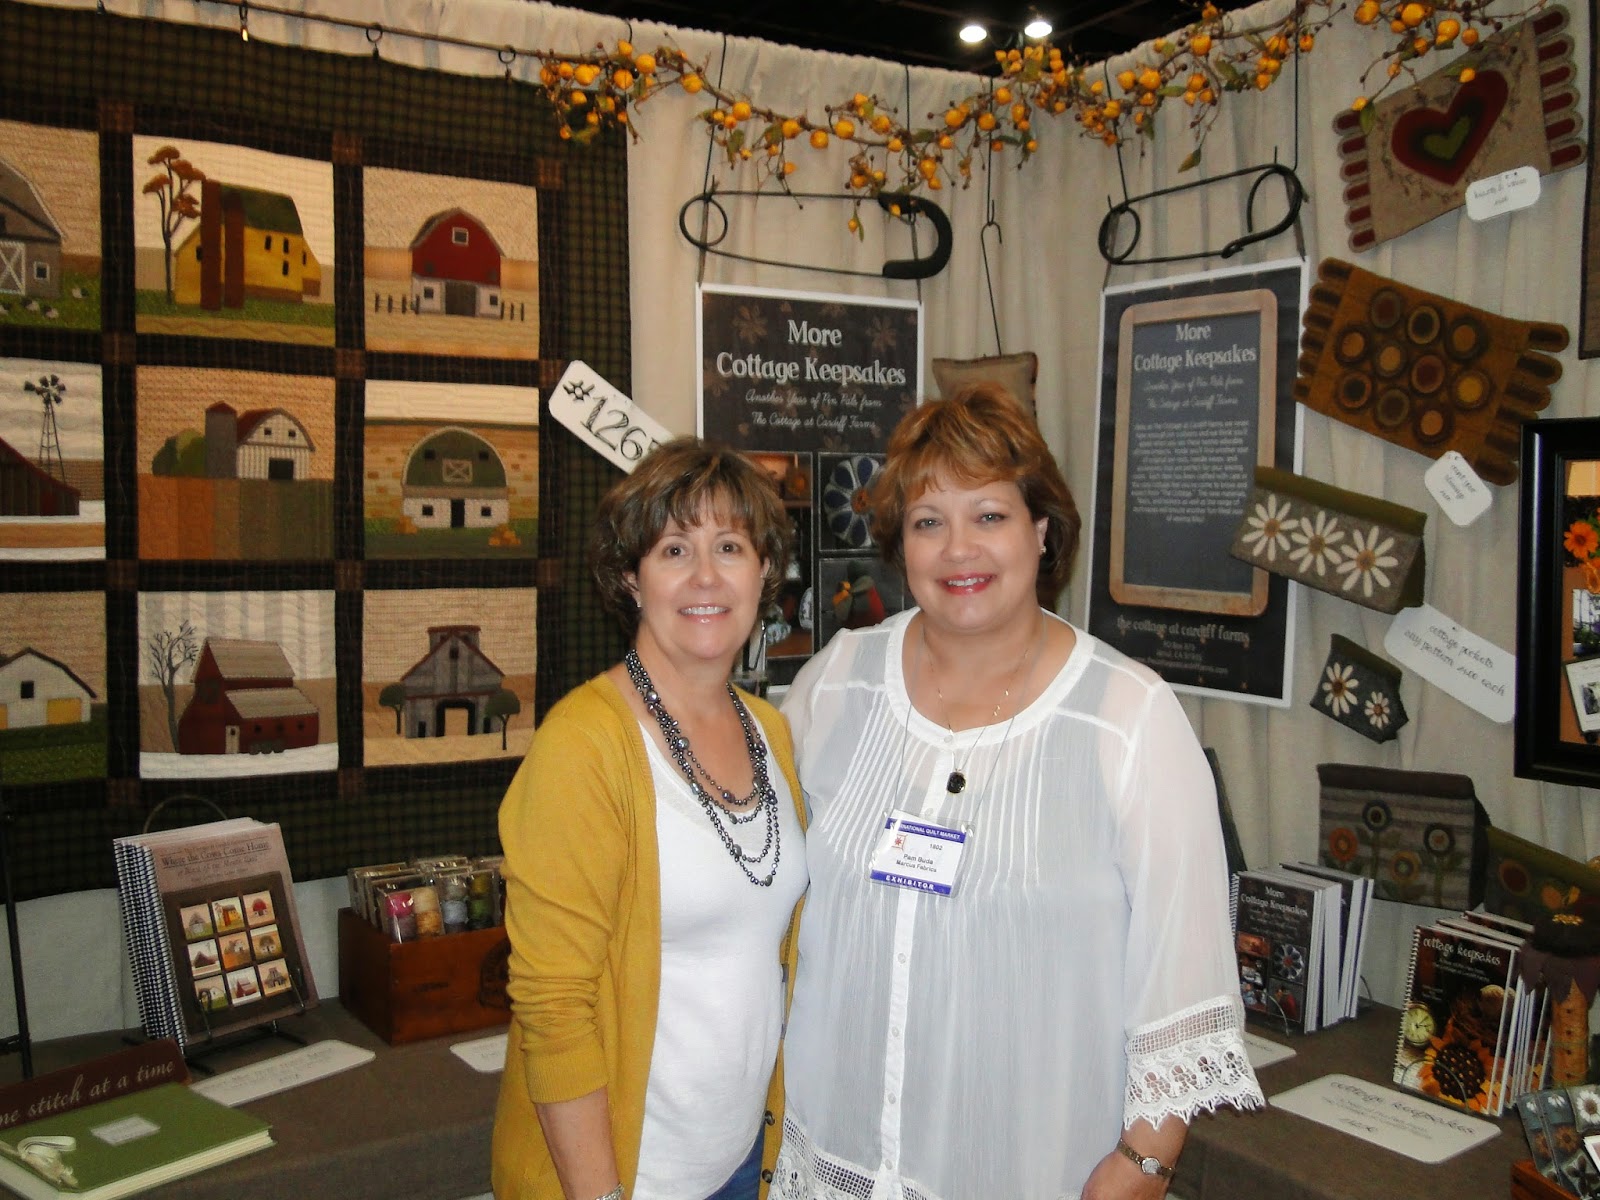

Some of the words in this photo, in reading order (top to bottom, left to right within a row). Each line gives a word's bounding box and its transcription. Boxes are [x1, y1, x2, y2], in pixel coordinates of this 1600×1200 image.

[788, 319, 842, 347] More
[1175, 323, 1211, 342] More
[716, 351, 800, 385] Cottage
[804, 356, 906, 387] Keepsakes
[1134, 353, 1183, 374] Cottage
[1185, 344, 1257, 369] Keepsakes
[745, 388, 784, 404] Another
[810, 392, 822, 410] of
[859, 394, 882, 412] from
[751, 411, 767, 426] The
[769, 412, 802, 431] Cottage
[804, 416, 815, 427] at
[816, 413, 848, 432] Cardiff
[849, 415, 876, 428] Farms
[1117, 615, 1132, 630] the
[1218, 625, 1251, 643] farms
[1481, 678, 1505, 697] each
[926, 828, 940, 837] QUILT
[940, 830, 961, 840] MARKET
[161, 856, 186, 867] Where
[187, 852, 198, 862] the
[223, 845, 245, 856] Come
[246, 841, 270, 851] Home
[903, 853, 917, 862] Pam
[896, 860, 916, 869] Marcus
[917, 864, 938, 873] Fabrics
[885, 874, 935, 890] EXHIBITOR
[1265, 886, 1285, 899] More
[1240, 893, 1269, 908] Cottage
[1269, 899, 1309, 918] Keepsakes
[1423, 937, 1454, 957] cottage
[1457, 942, 1501, 966] keepsakes
[28, 1073, 84, 1118] stitch
[90, 1077, 111, 1097] at
[117, 1075, 128, 1089] a
[136, 1060, 175, 1082] time
[1330, 1080, 1385, 1103] cottage
[1391, 1101, 1476, 1135] keepsakes
